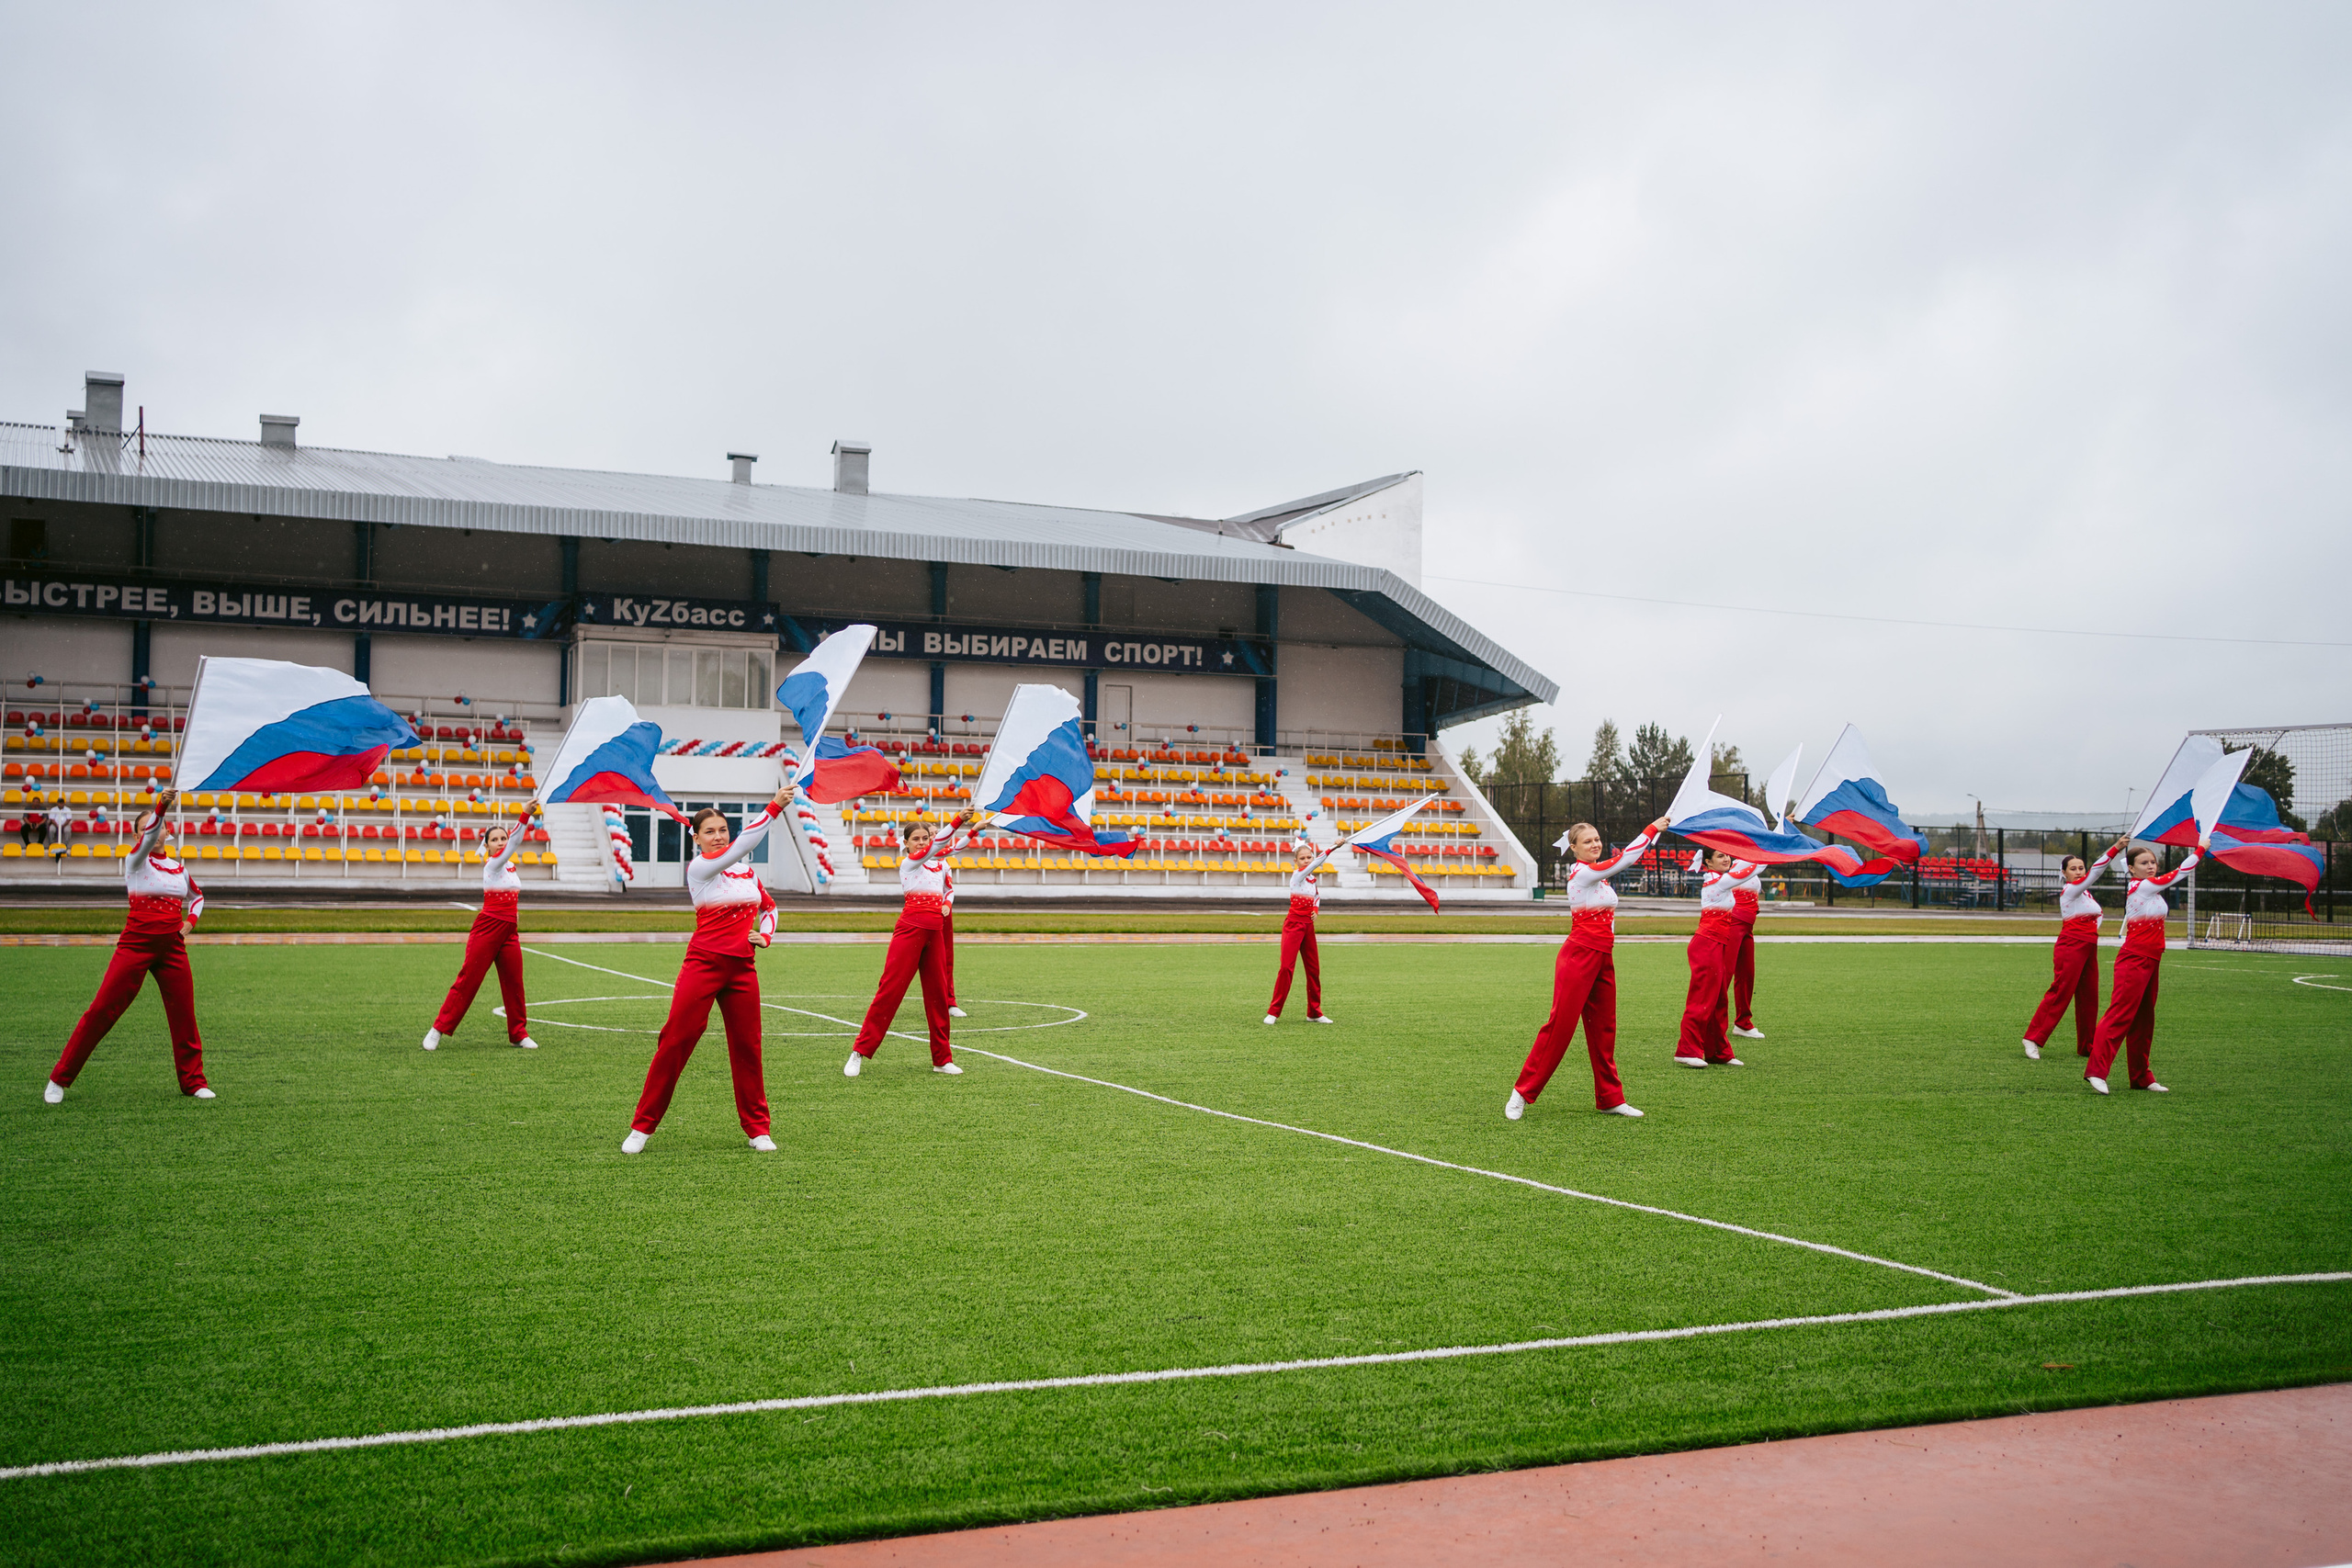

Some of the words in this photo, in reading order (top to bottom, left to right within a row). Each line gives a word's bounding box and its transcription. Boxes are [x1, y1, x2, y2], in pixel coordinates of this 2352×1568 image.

[0, 580, 179, 619] ЫСТРЕЕ,
[192, 591, 322, 626] ВЫШЕ,
[334, 599, 510, 631] СИЛЬНЕЕ!
[613, 598, 745, 626] КуZбасс
[923, 632, 1087, 660] ВЫБИРАЕМ
[1104, 641, 1203, 667] СПОРТ!
